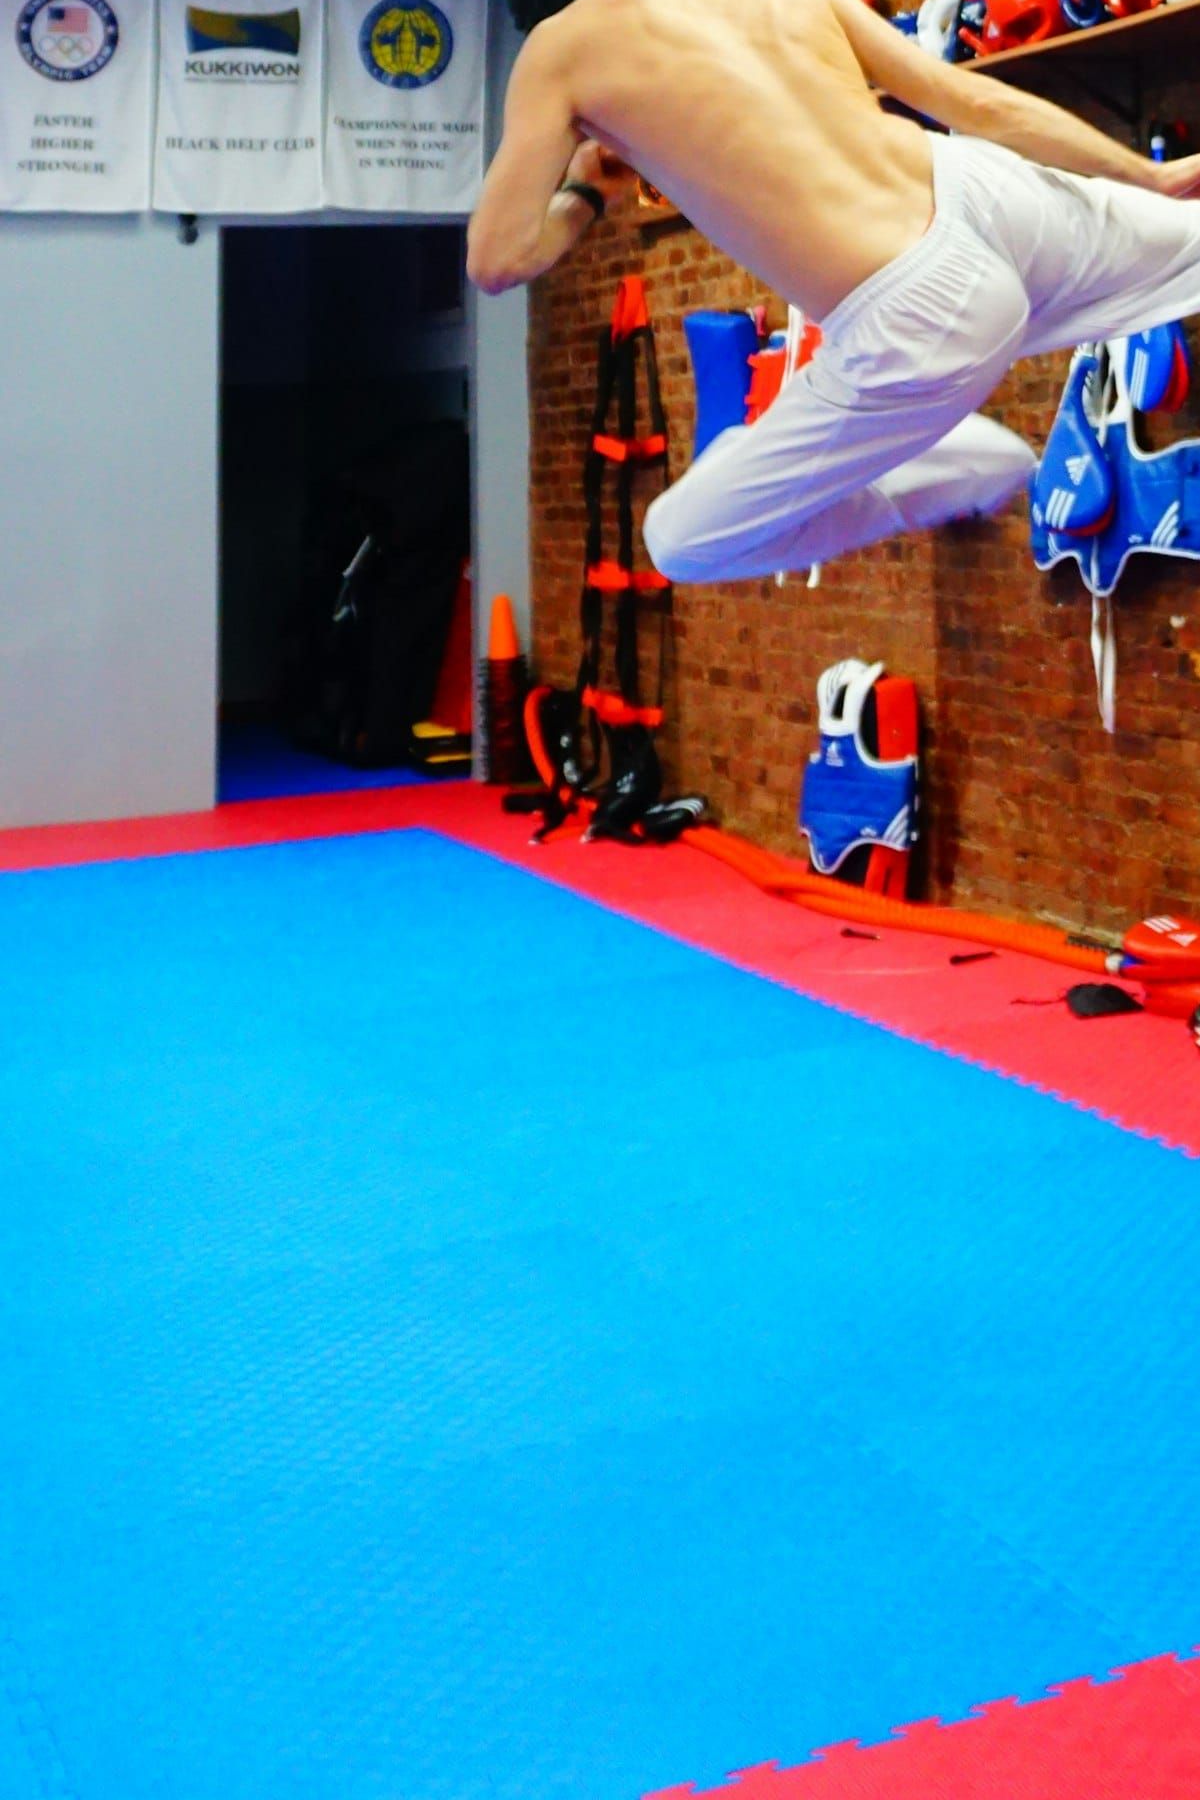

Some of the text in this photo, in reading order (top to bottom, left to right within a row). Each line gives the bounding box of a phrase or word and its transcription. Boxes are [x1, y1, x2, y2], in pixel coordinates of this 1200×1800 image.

[185, 60, 300, 76] KUKKIWON
[34, 113, 94, 129] FASTER
[410, 121, 436, 132] ARE
[442, 122, 479, 133] MADE
[31, 136, 94, 151] HIGHER
[165, 137, 315, 150] BLACK BELT CLUB
[355, 139, 395, 149] WHEN
[17, 159, 106, 175] STRONGER
[376, 158, 445, 170] WATCHING
